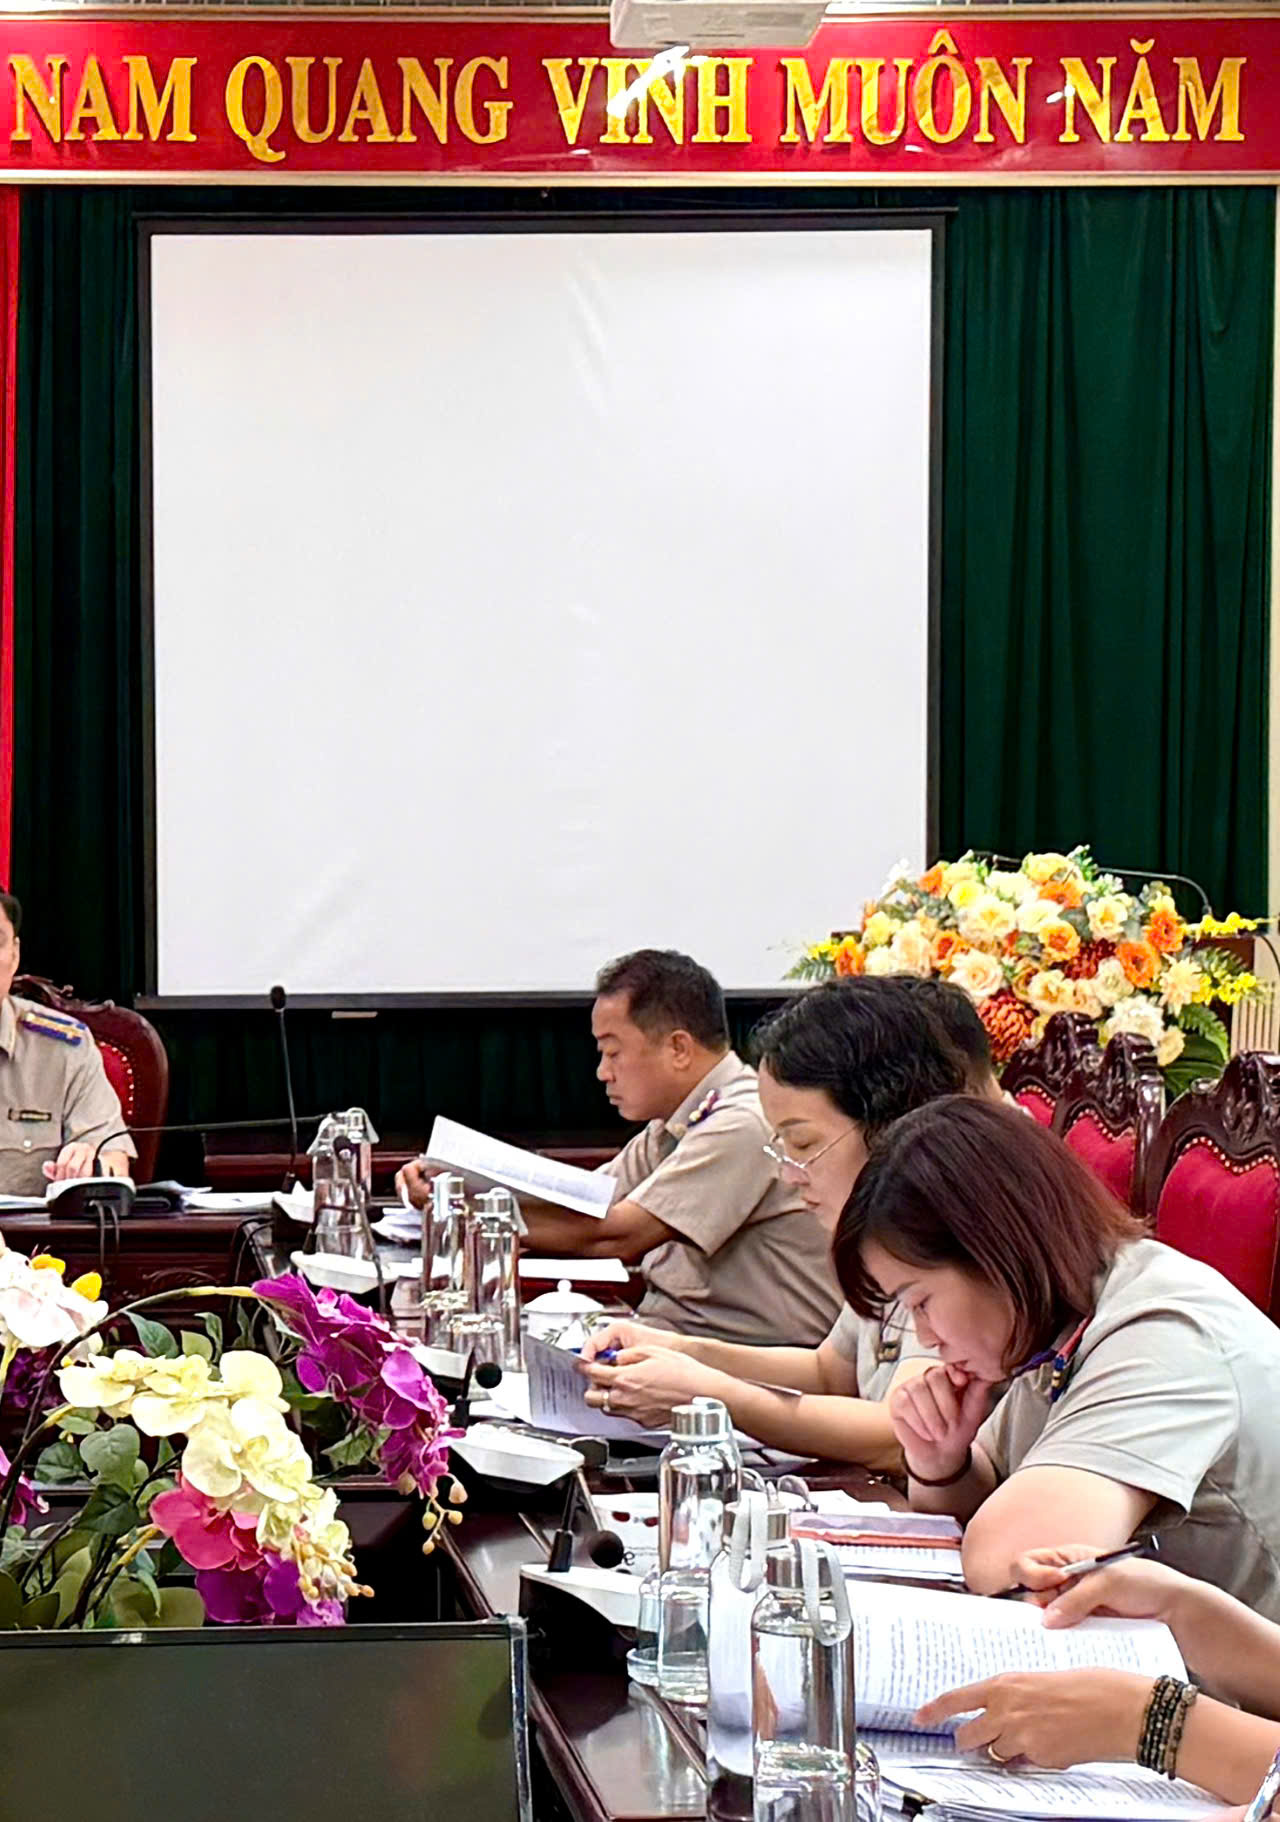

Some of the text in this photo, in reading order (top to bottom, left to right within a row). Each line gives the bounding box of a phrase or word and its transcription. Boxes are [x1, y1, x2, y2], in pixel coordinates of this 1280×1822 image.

[9, 54, 198, 142] NAM
[225, 55, 514, 163] QUANG
[542, 56, 753, 145] VINH
[781, 29, 1032, 145] MUÔN
[1060, 38, 1247, 143] NĂM
